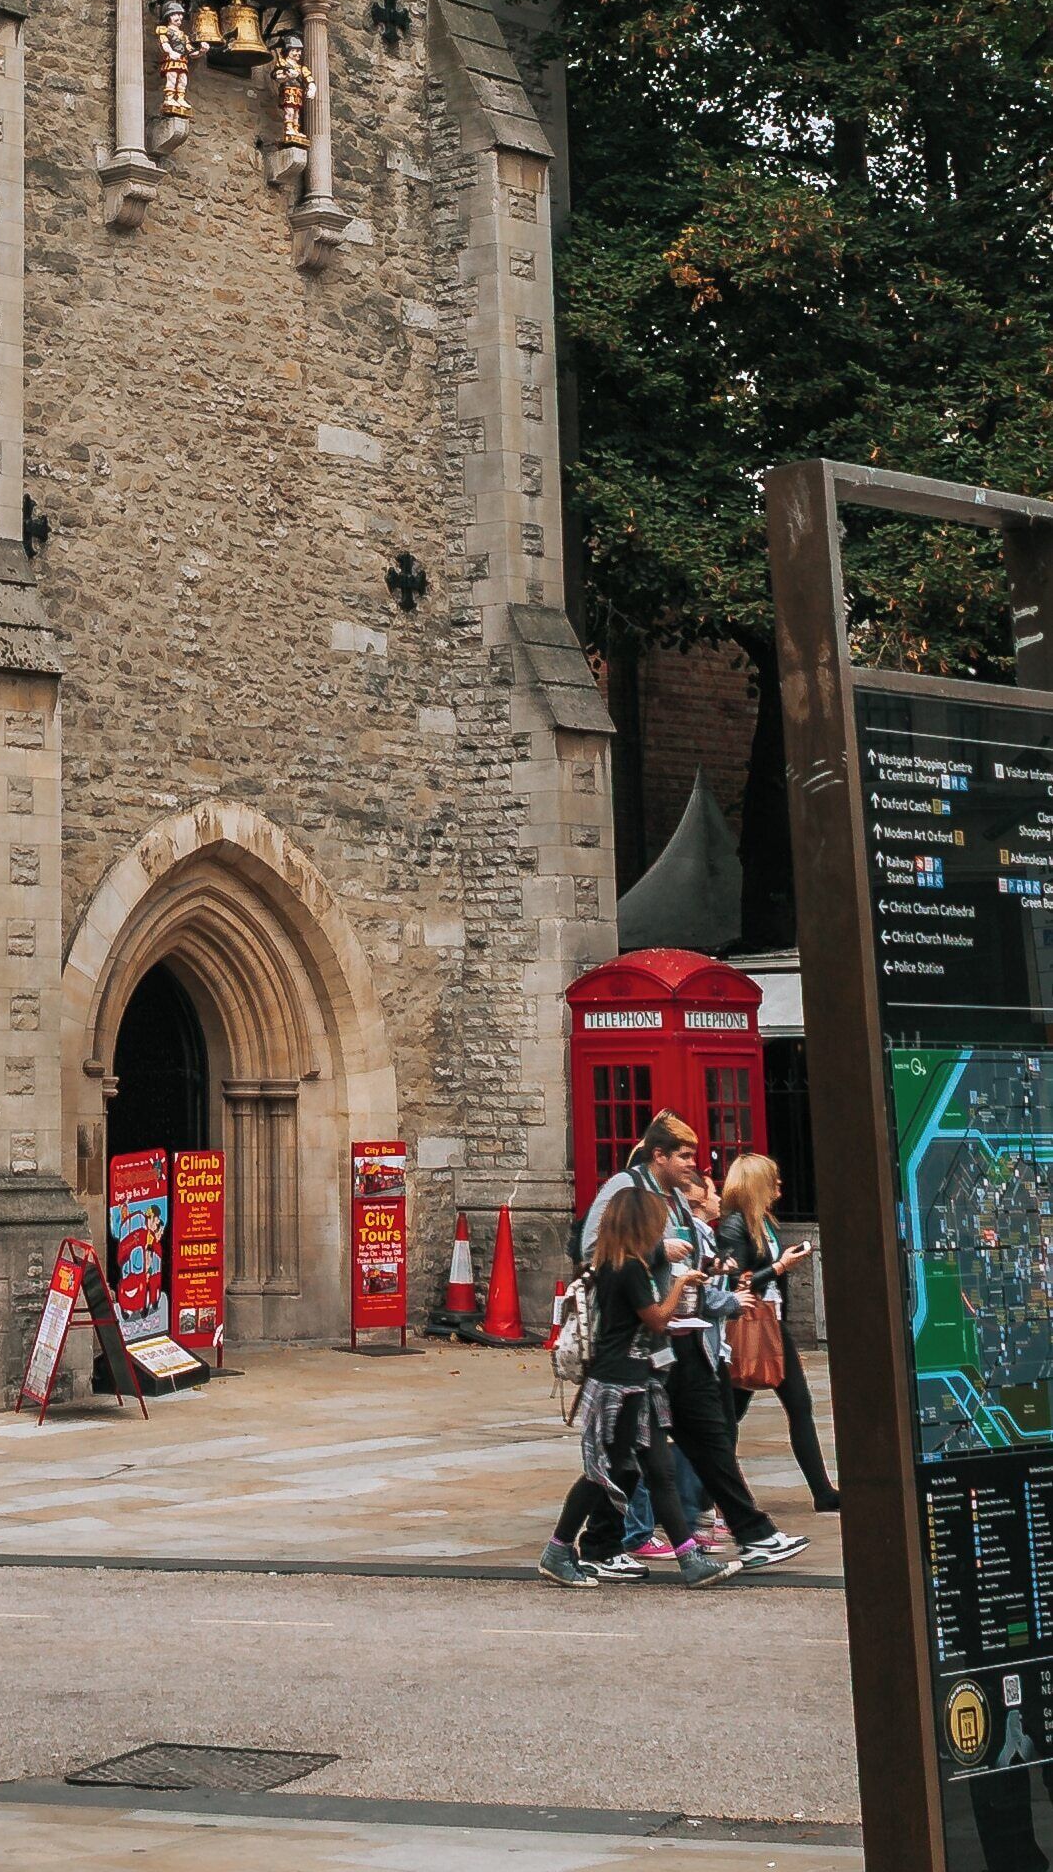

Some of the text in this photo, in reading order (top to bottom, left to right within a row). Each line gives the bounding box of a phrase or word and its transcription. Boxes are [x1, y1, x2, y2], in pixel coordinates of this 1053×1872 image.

[878, 752, 973, 774] Westgate Shopping Centre
[879, 768, 940, 788] & Central Library
[1005, 766, 1028, 779] Visitor
[881, 797, 932, 813] Oxford Castle
[883, 826, 953, 843] Modern Art Oxford
[1019, 824, 1051, 841] Shopping
[885, 855, 914, 872] Railway
[1010, 852, 1047, 866] Ashmolean
[887, 871, 915, 885] Station
[889, 900, 975, 918] Christ Church Cathedral
[1020, 896, 1042, 908] Green
[892, 931, 974, 946] Christ Church Meadow
[894, 960, 945, 975] Police Station
[587, 1011, 661, 1028] TELEPHONE
[685, 1012, 747, 1029] TELEPHONE
[364, 1146, 396, 1156] City Bus
[180, 1154, 220, 1170] Climb
[176, 1171, 223, 1187] Carfax
[178, 1189, 221, 1204] Tower
[364, 1211, 395, 1229] City
[358, 1228, 402, 1242] Tours
[180, 1243, 217, 1256] INSIDE
[1041, 1670, 1051, 1681] TO
